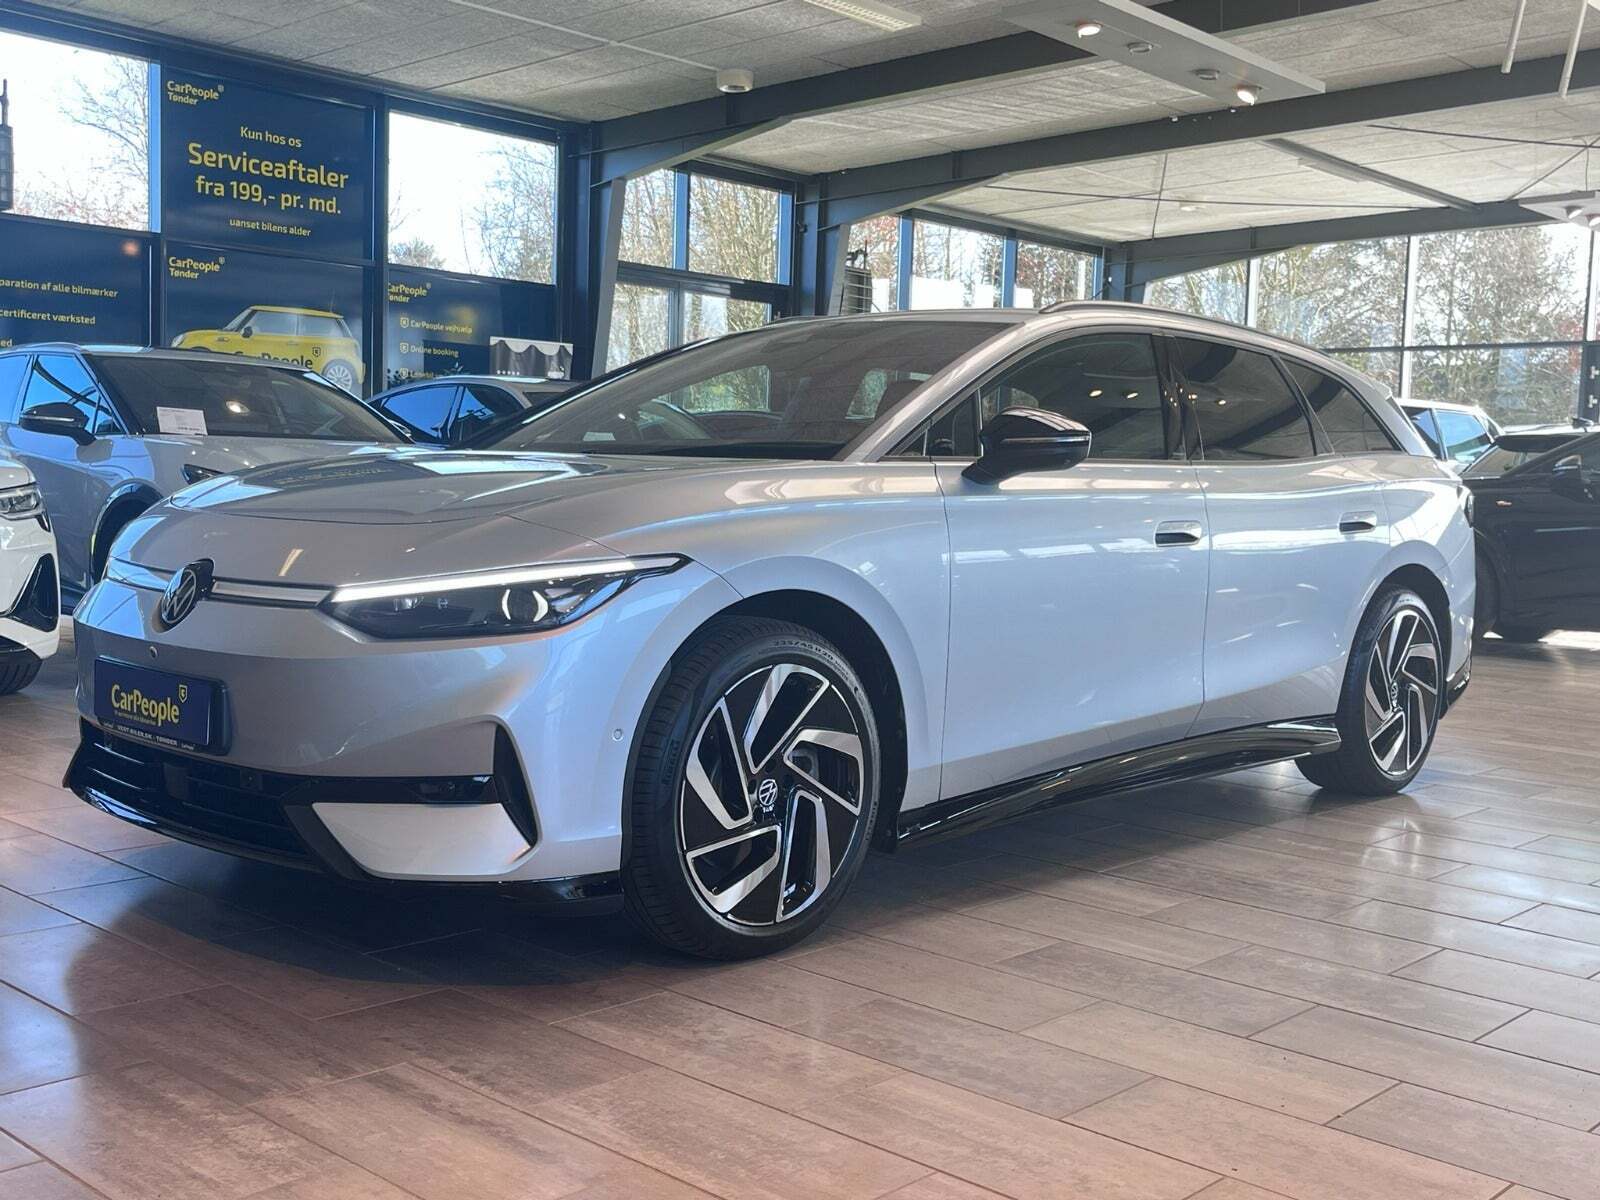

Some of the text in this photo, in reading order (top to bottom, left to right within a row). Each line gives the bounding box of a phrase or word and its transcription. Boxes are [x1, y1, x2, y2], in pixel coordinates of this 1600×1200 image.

[167, 80, 220, 100] CarPeople
[240, 126, 302, 148] Kun hos os
[188, 142, 349, 189] Serviceaftaler
[196, 175, 341, 214] fra 199,- pr. md.
[230, 218, 311, 237] uanset bilens alder
[169, 256, 220, 272] CarPeople
[41, 282, 52, 291] af
[53, 283, 70, 293] alle
[72, 285, 118, 298] bilmærker
[52, 313, 96, 325] værksted
[111, 684, 180, 727] CarPeople
